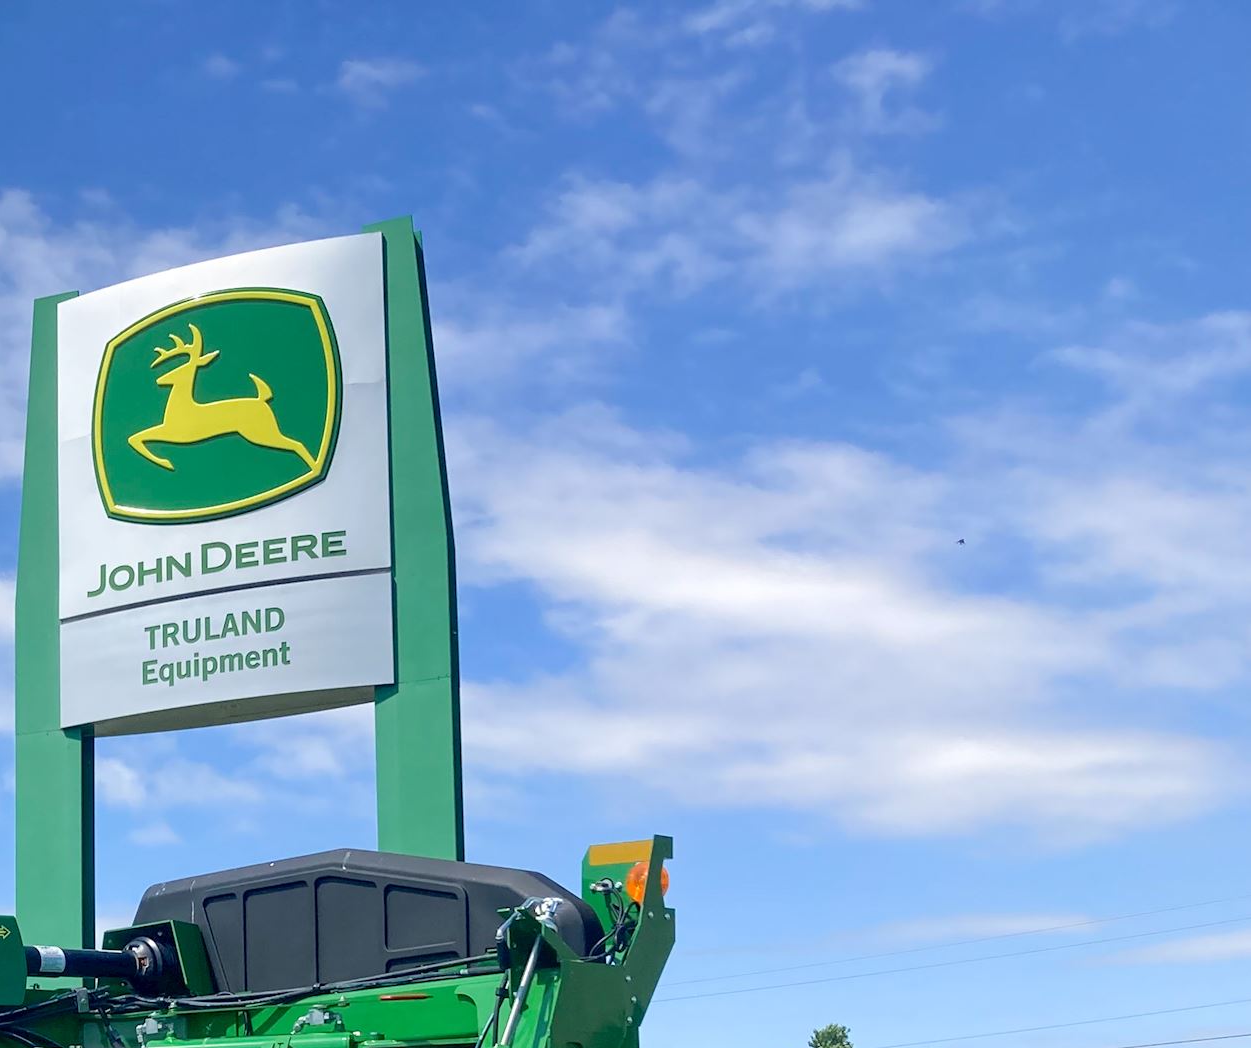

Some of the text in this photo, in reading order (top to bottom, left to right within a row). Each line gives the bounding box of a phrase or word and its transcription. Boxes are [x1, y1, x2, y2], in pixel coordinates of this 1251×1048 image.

[87, 530, 347, 597] JOHN DEERE
[144, 607, 286, 650] TRULAND
[142, 641, 291, 686] Equipment
